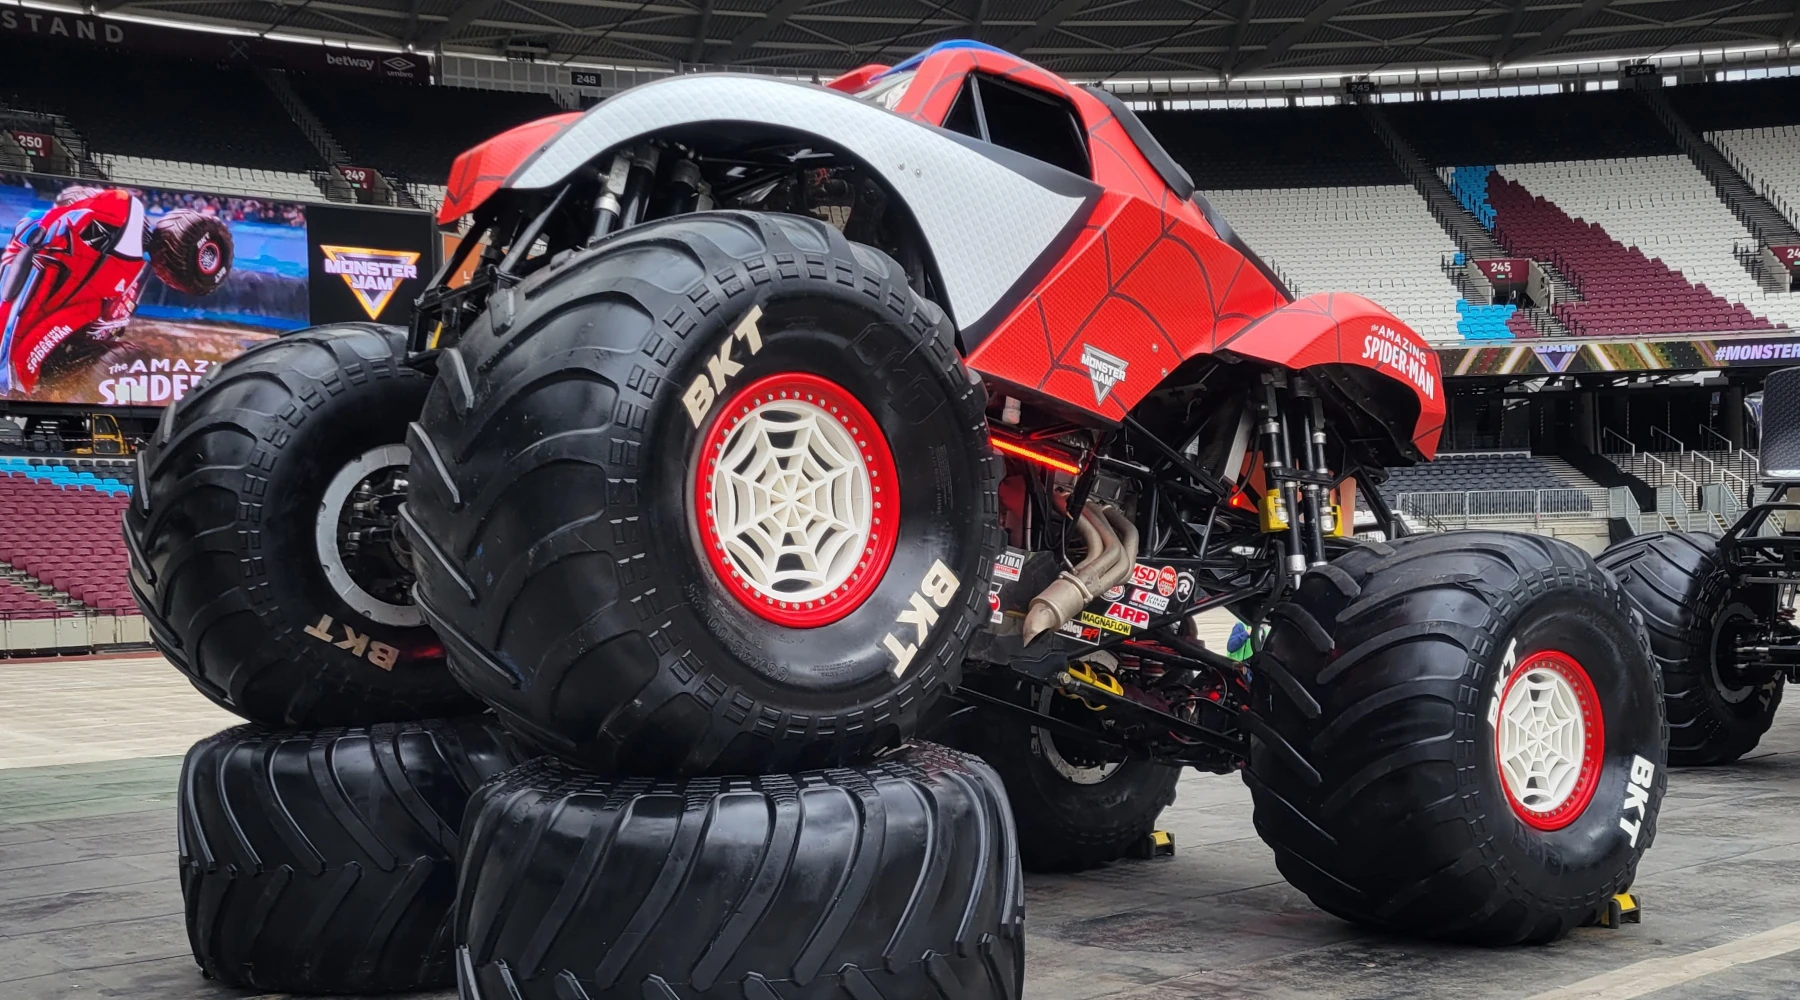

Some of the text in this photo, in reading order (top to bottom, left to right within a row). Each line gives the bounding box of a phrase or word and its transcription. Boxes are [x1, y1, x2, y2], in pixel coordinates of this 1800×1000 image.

[1, 9, 124, 43] STAND
[326, 53, 375, 71] betway
[1630, 67, 1651, 75] 244
[387, 70, 414, 78] umbro
[576, 74, 597, 84] 248
[1351, 83, 1370, 92] 245
[18, 135, 43, 149] 250
[345, 169, 366, 181] 249
[1787, 248, 1800, 259] 24
[324, 259, 418, 279] MONSTER
[1490, 262, 1511, 273] 245
[351, 275, 393, 291] JAM
[1378, 325, 1427, 365] AMAZING
[109, 358, 209, 375] The AMAZ
[682, 304, 763, 430] BKT
[1081, 353, 1126, 382] MONSTER
[1092, 370, 1112, 387] JAM
[98, 374, 202, 405] SPIDE
[996, 554, 1021, 569] TIMA
[883, 558, 960, 679] BKT
[1082, 612, 1130, 633] MAGNAFLOW
[1107, 603, 1149, 624] ARP
[1061, 620, 1083, 638] olley
[303, 613, 400, 672] BKT
[1619, 754, 1655, 848] BKT
